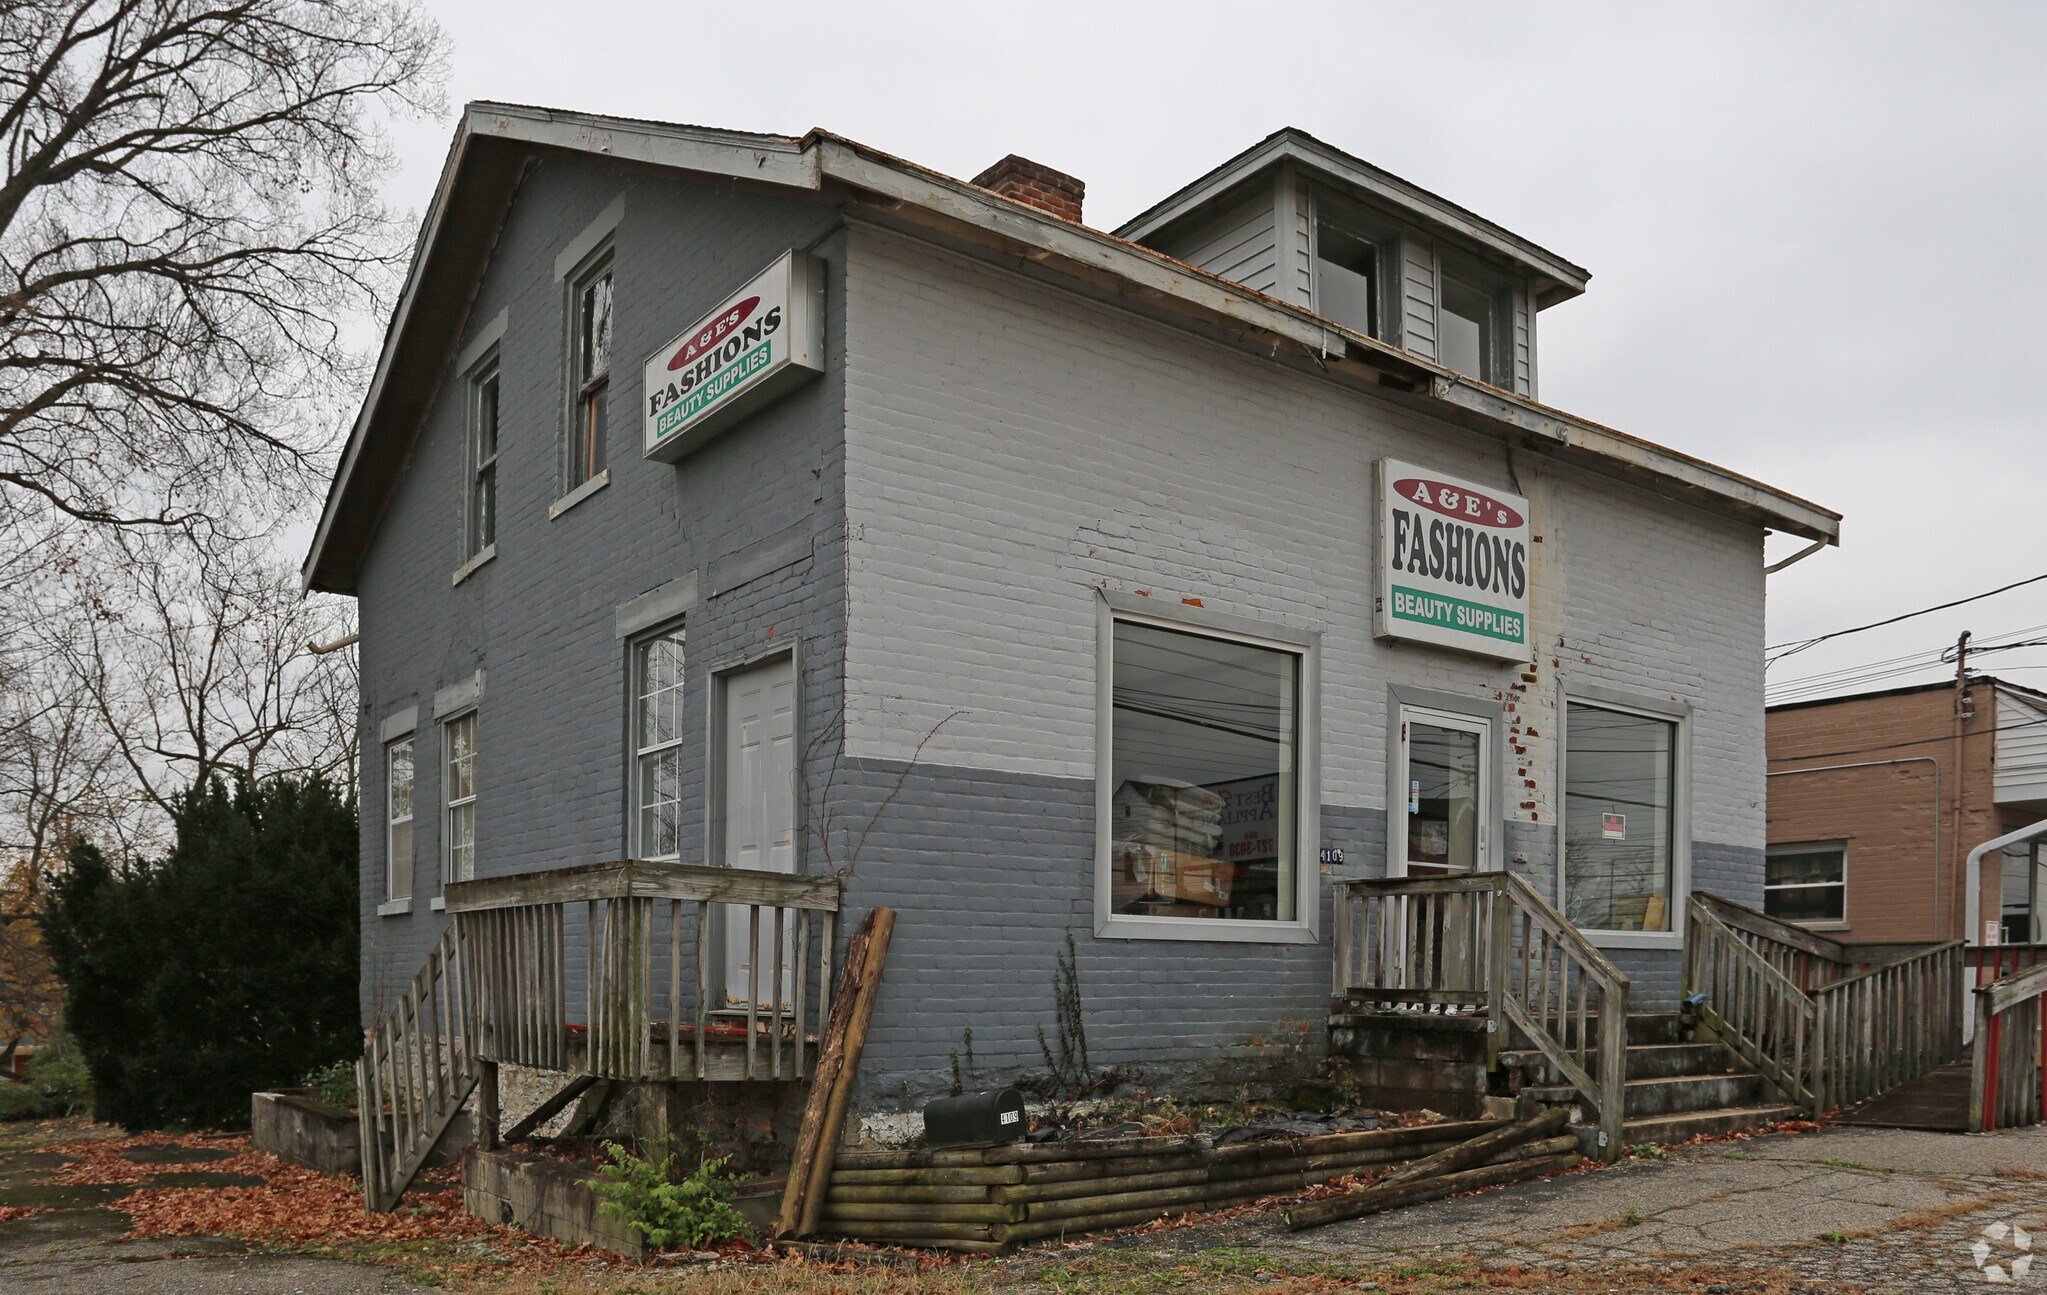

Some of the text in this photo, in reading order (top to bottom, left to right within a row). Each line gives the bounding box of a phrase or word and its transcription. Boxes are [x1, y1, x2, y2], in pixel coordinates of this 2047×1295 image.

[649, 305, 781, 418] FASHIONS
[658, 346, 768, 433] BEAUTY SUPPLIES
[1392, 508, 1526, 600] FASHIONS
[1394, 591, 1454, 622] BEAUTY
[1456, 605, 1522, 638] SUPPLIES
[1320, 849, 1343, 862] 4109
[1002, 1111, 1018, 1124] 4109
